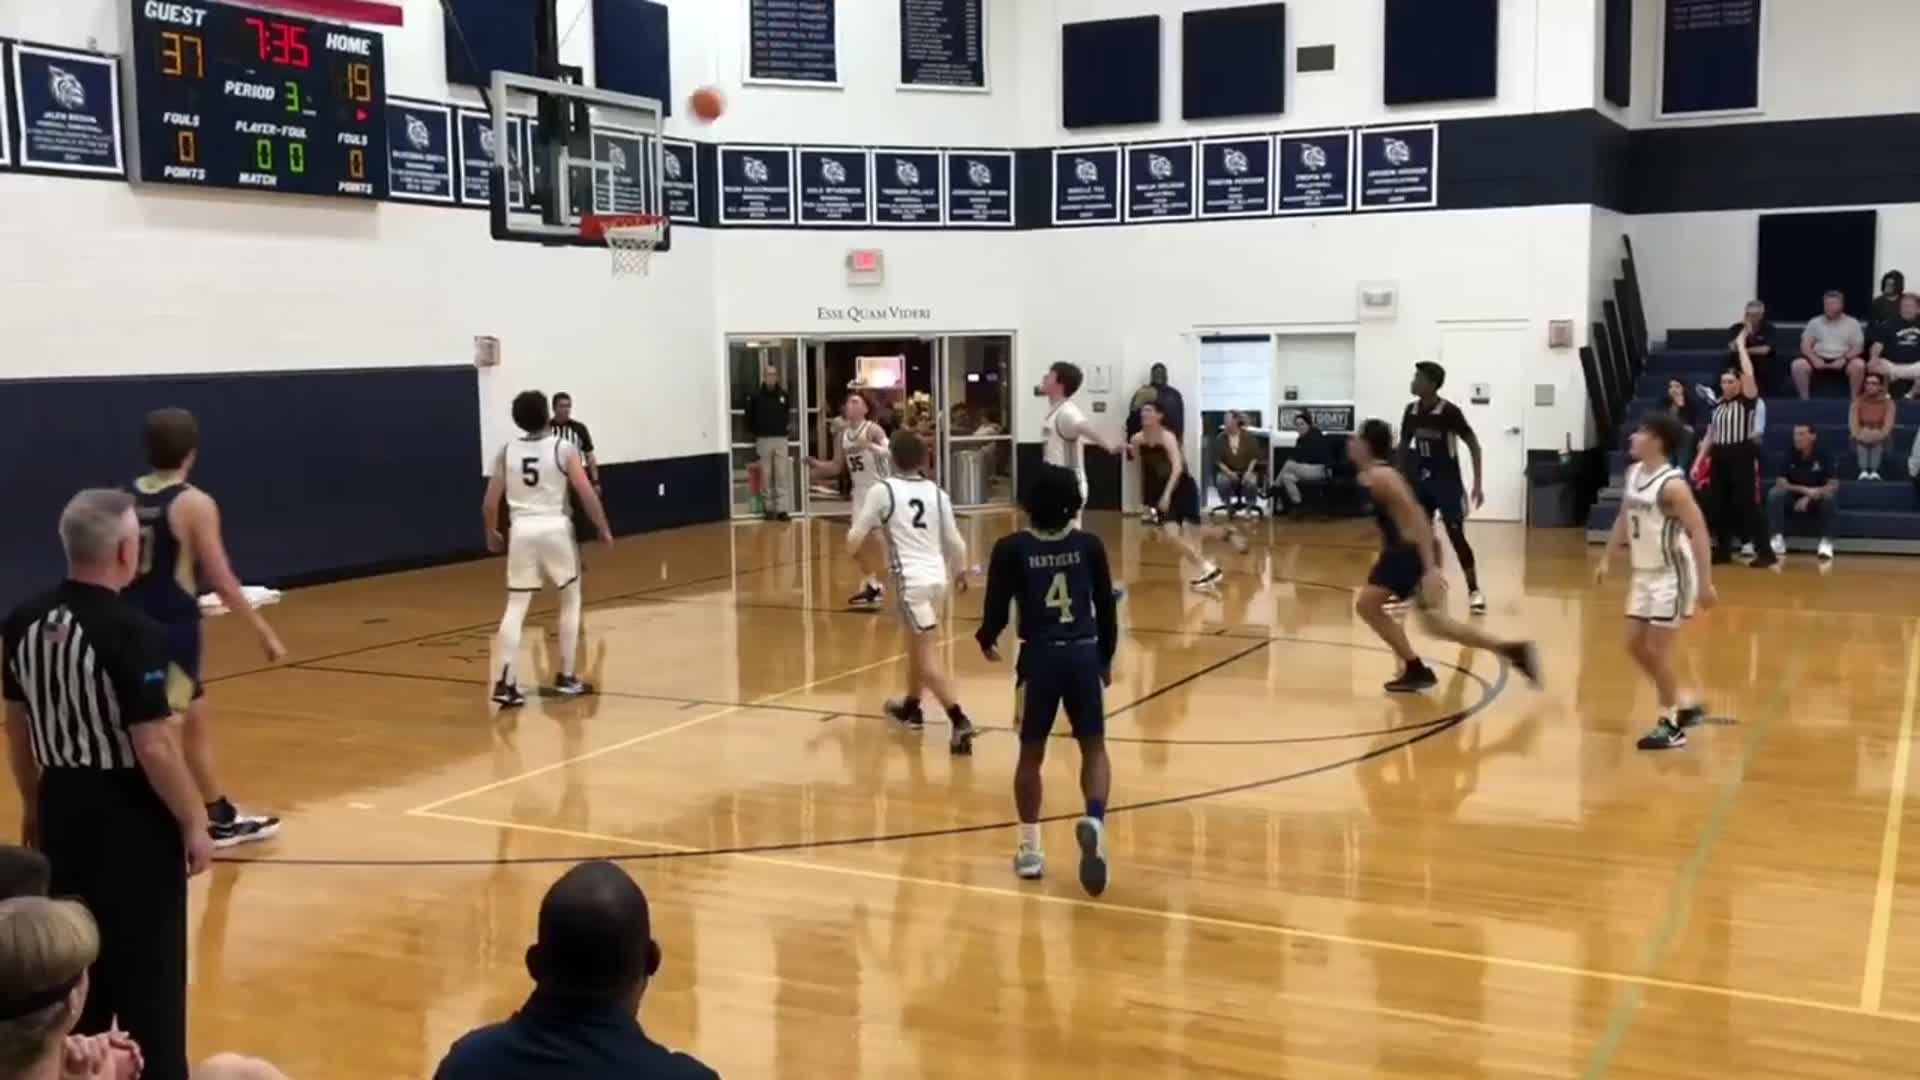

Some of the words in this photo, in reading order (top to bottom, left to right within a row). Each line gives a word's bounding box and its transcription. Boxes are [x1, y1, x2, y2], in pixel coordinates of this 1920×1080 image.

[144, 1, 206, 26] GUEST
[160, 31, 205, 79] 37
[245, 18, 311, 69] 7:35
[326, 32, 371, 55] HOME
[224, 80, 275, 100] PERIOD
[284, 82, 299, 112] 3
[346, 63, 371, 101] 19
[163, 111, 200, 126] FOULS
[235, 120, 307, 138] PLAYER-FOUL
[177, 130, 194, 162] 0
[338, 132, 368, 146] FOULS
[256, 139, 272, 170] 0
[289, 143, 304, 172] 0
[350, 149, 364, 178] 0
[164, 165, 206, 180] POINTS
[238, 172, 277, 186] MATCH
[338, 181, 373, 194] POINTS
[816, 307, 844, 320] ESSE
[847, 306, 886, 323] QUAM
[889, 306, 931, 320] VIDERI
[522, 457, 540, 487] 5
[908, 498, 927, 529] 2
[1044, 572, 1075, 623] 4
